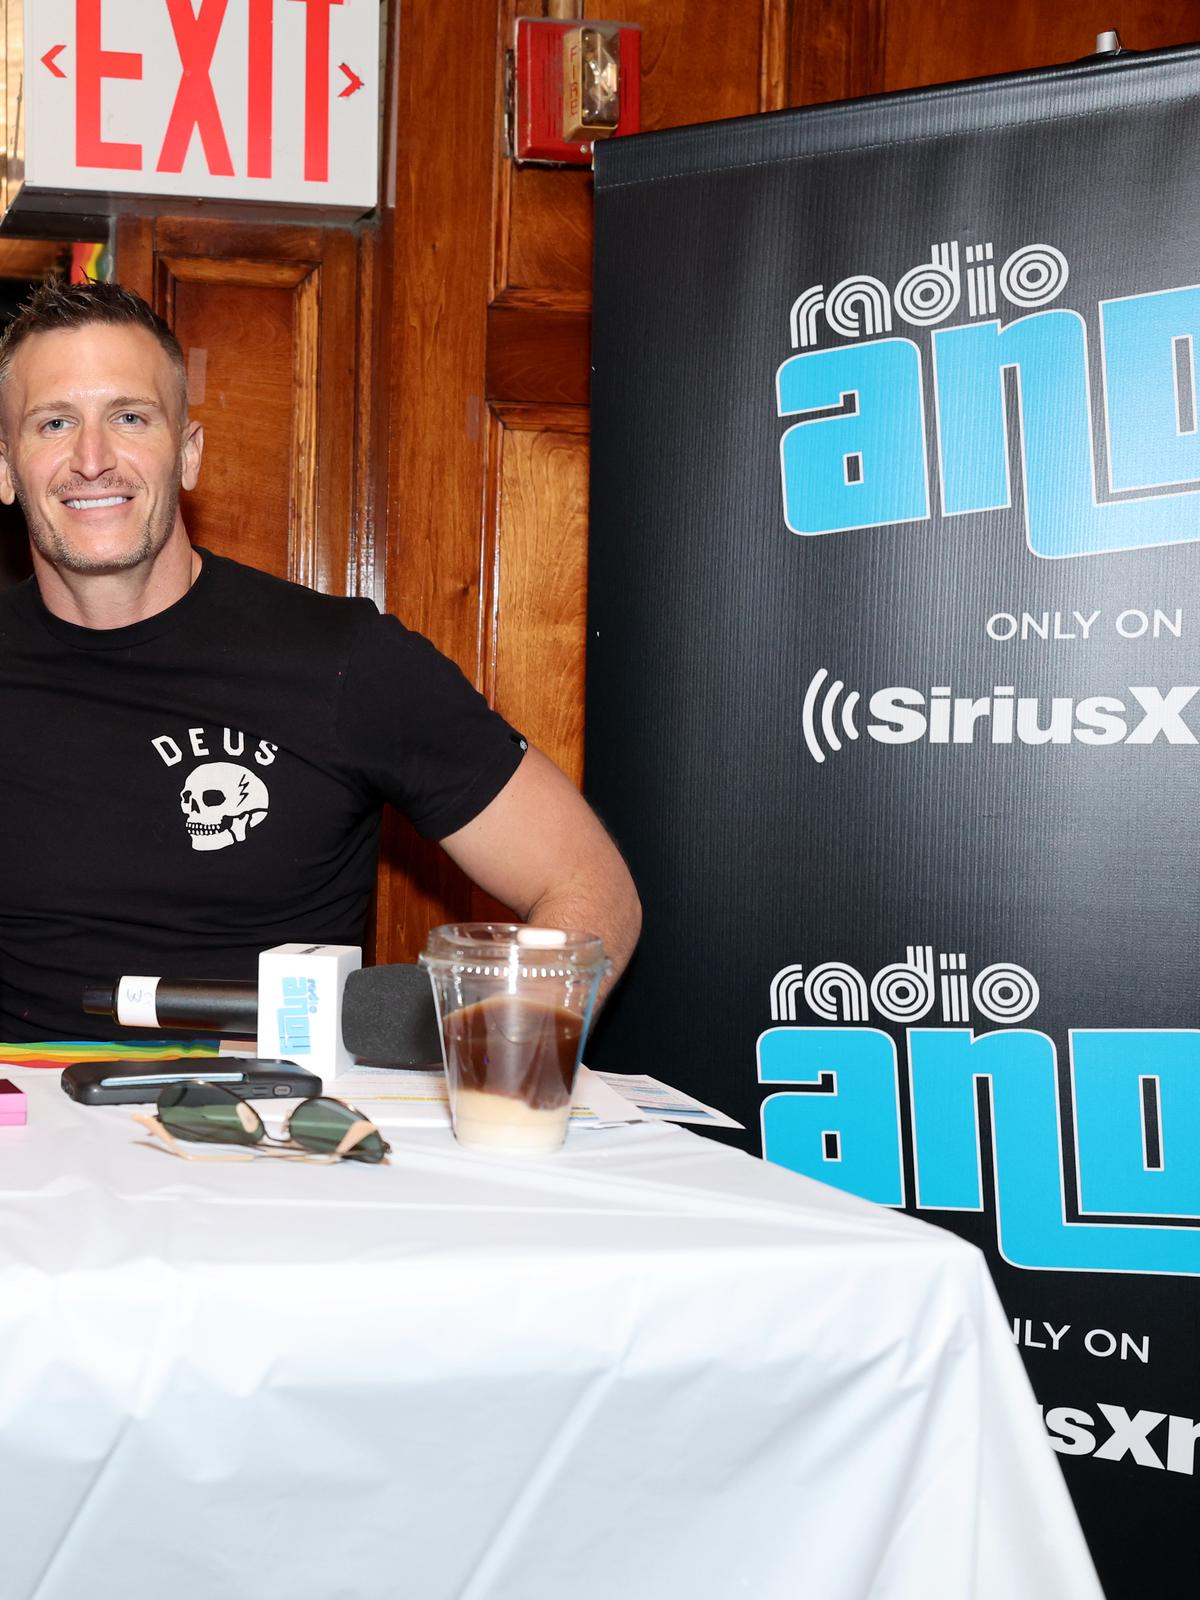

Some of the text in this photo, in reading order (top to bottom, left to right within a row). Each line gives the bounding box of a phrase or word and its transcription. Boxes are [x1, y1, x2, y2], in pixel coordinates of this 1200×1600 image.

[75, 0, 344, 182] EXIT
[569, 45, 579, 116] FIRE
[790, 241, 1069, 348] radio
[987, 609, 1183, 641] ONLY ON
[151, 727, 278, 767] DEUS
[770, 946, 1040, 1023] radio
[1084, 1329, 1149, 1363] ON
